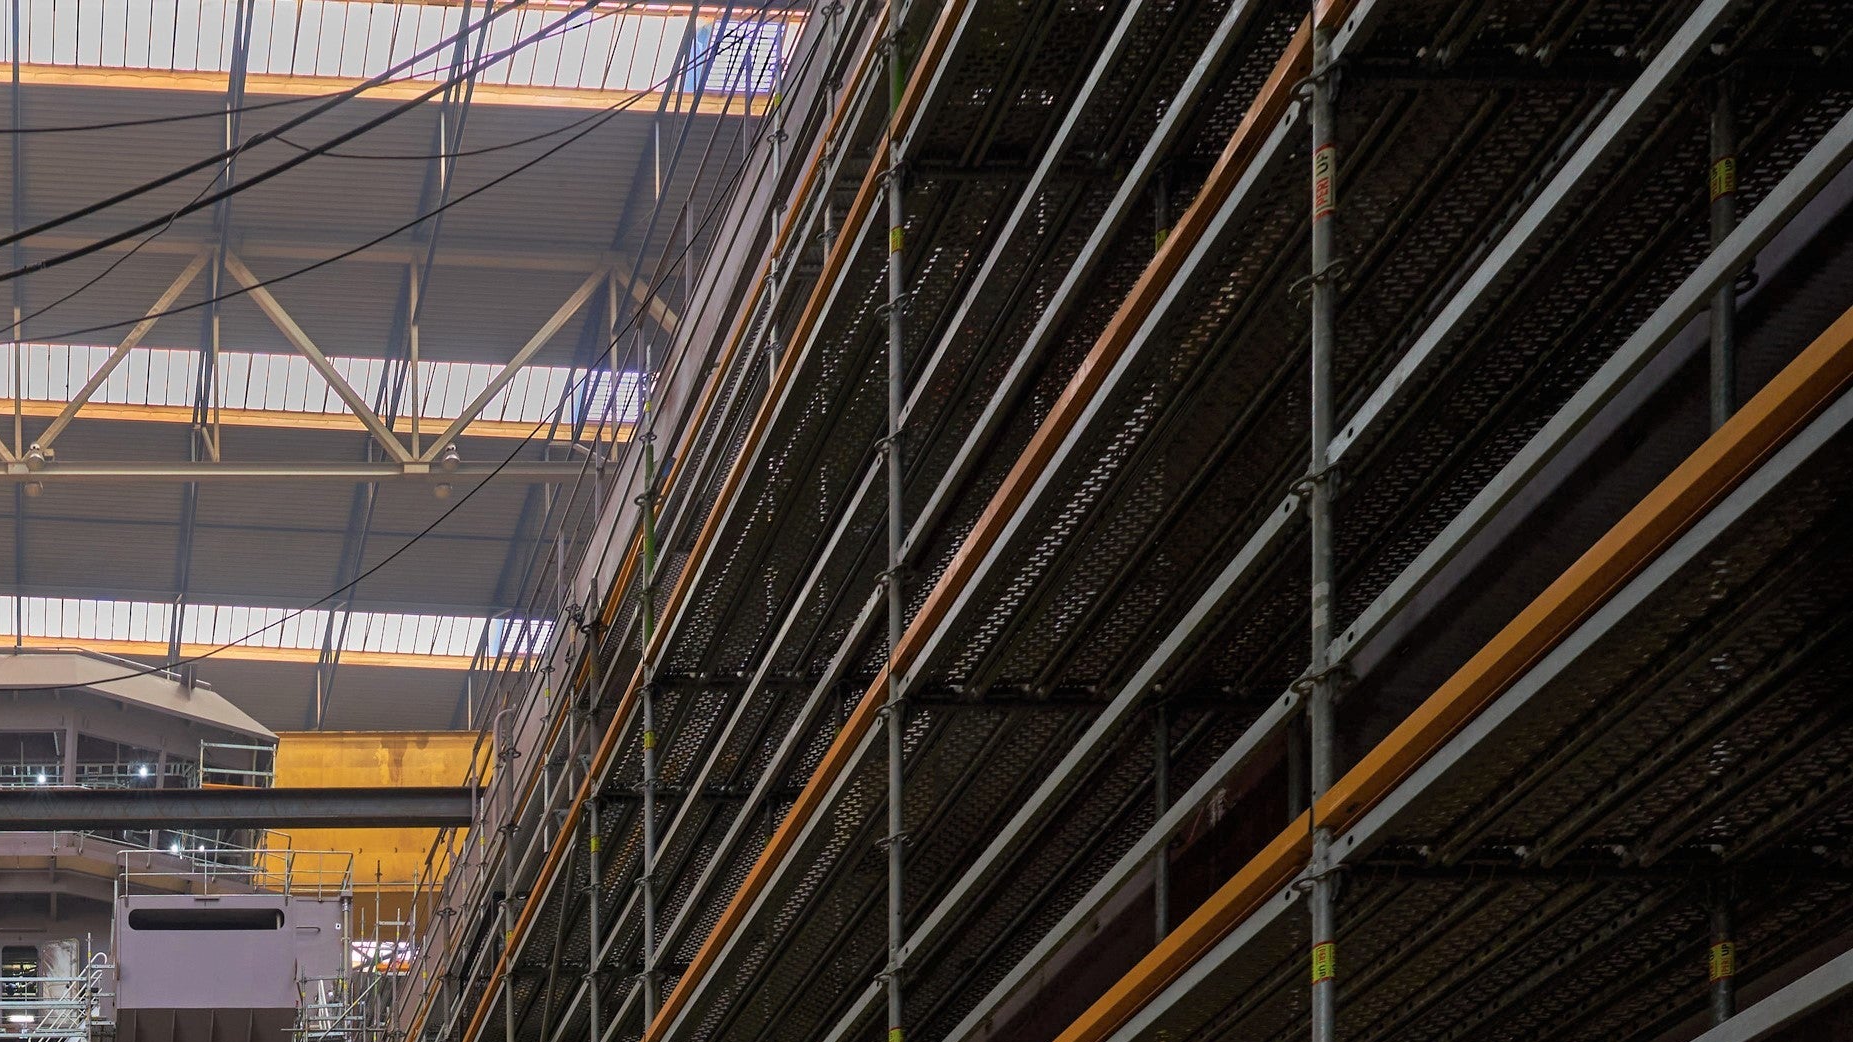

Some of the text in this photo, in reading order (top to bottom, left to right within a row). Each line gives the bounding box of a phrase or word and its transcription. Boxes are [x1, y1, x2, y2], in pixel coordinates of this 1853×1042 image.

[1316, 153, 1330, 209] PERI UP
[1722, 943, 1731, 956] UP
